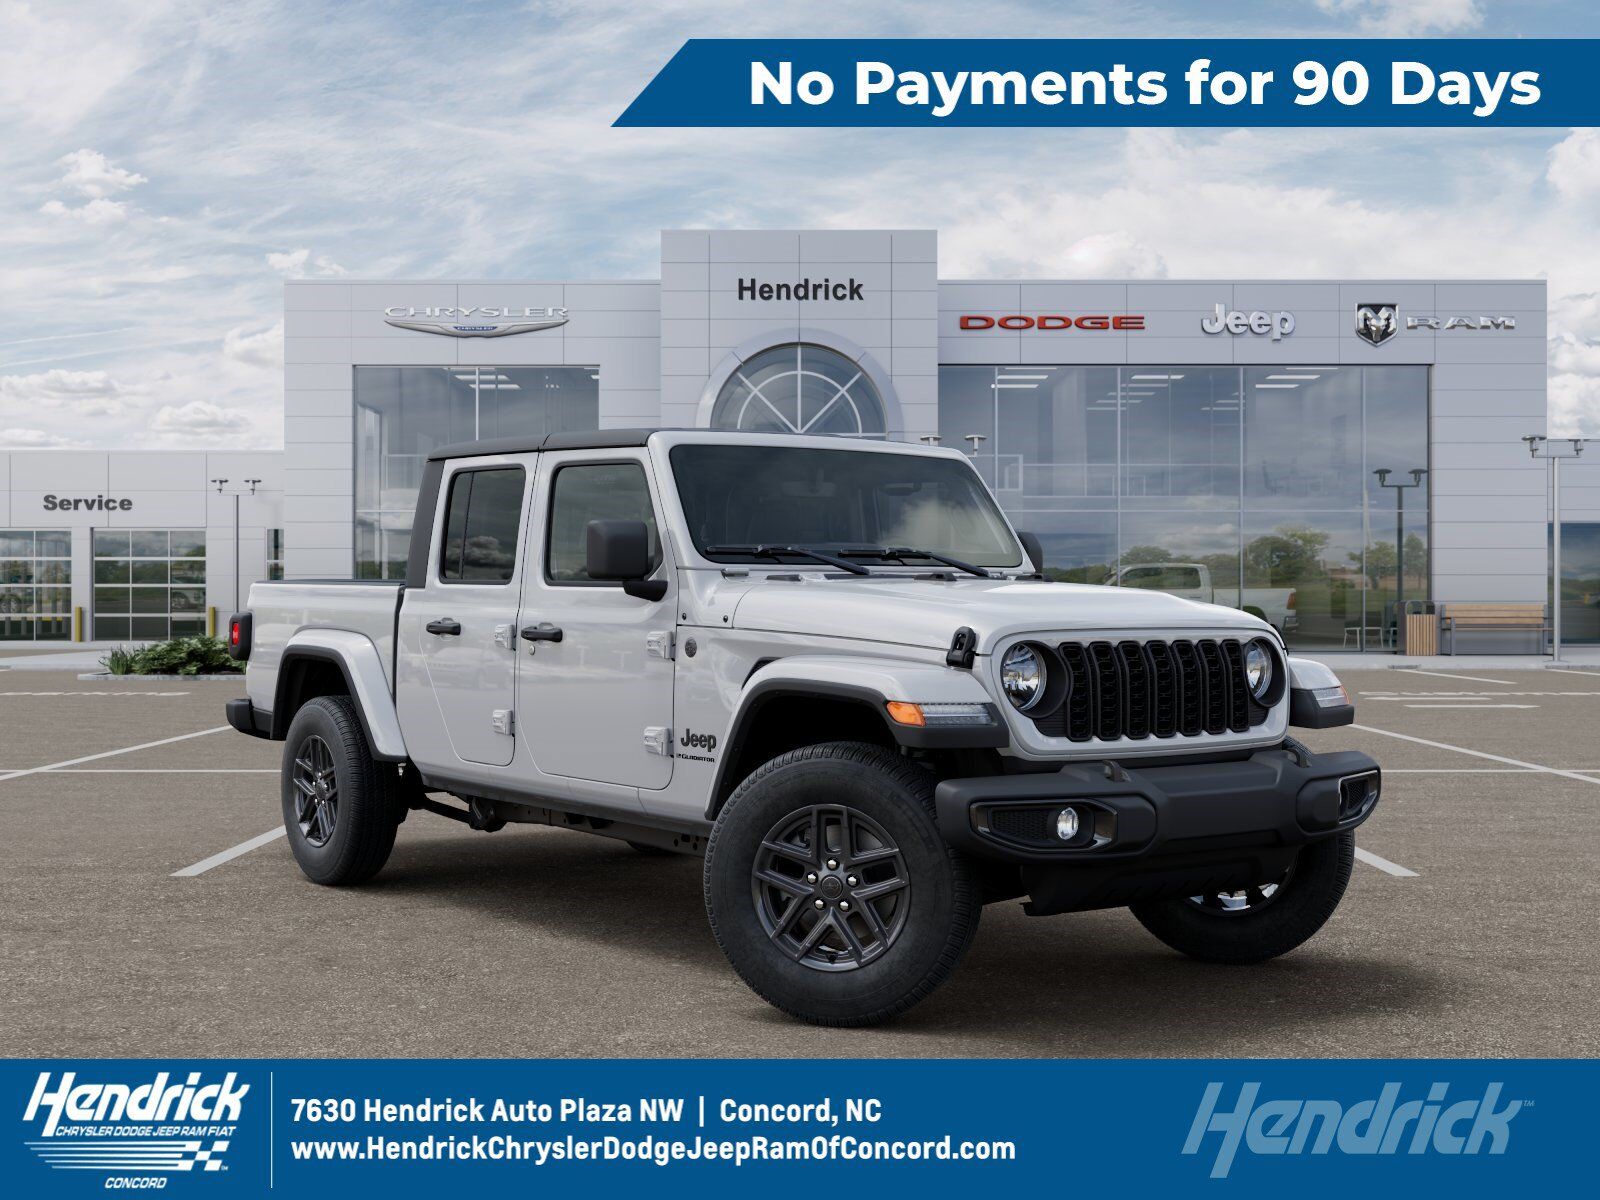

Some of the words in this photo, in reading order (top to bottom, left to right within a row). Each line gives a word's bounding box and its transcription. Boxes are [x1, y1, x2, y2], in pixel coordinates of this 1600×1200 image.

[738, 278, 864, 301] Hendrick
[385, 305, 569, 318] CHRYSLER
[959, 314, 1146, 330] DODGE
[1201, 303, 1295, 341] Jeep
[1406, 315, 1516, 331] RAM
[43, 494, 133, 511] Service
[680, 728, 717, 753] Jeep
